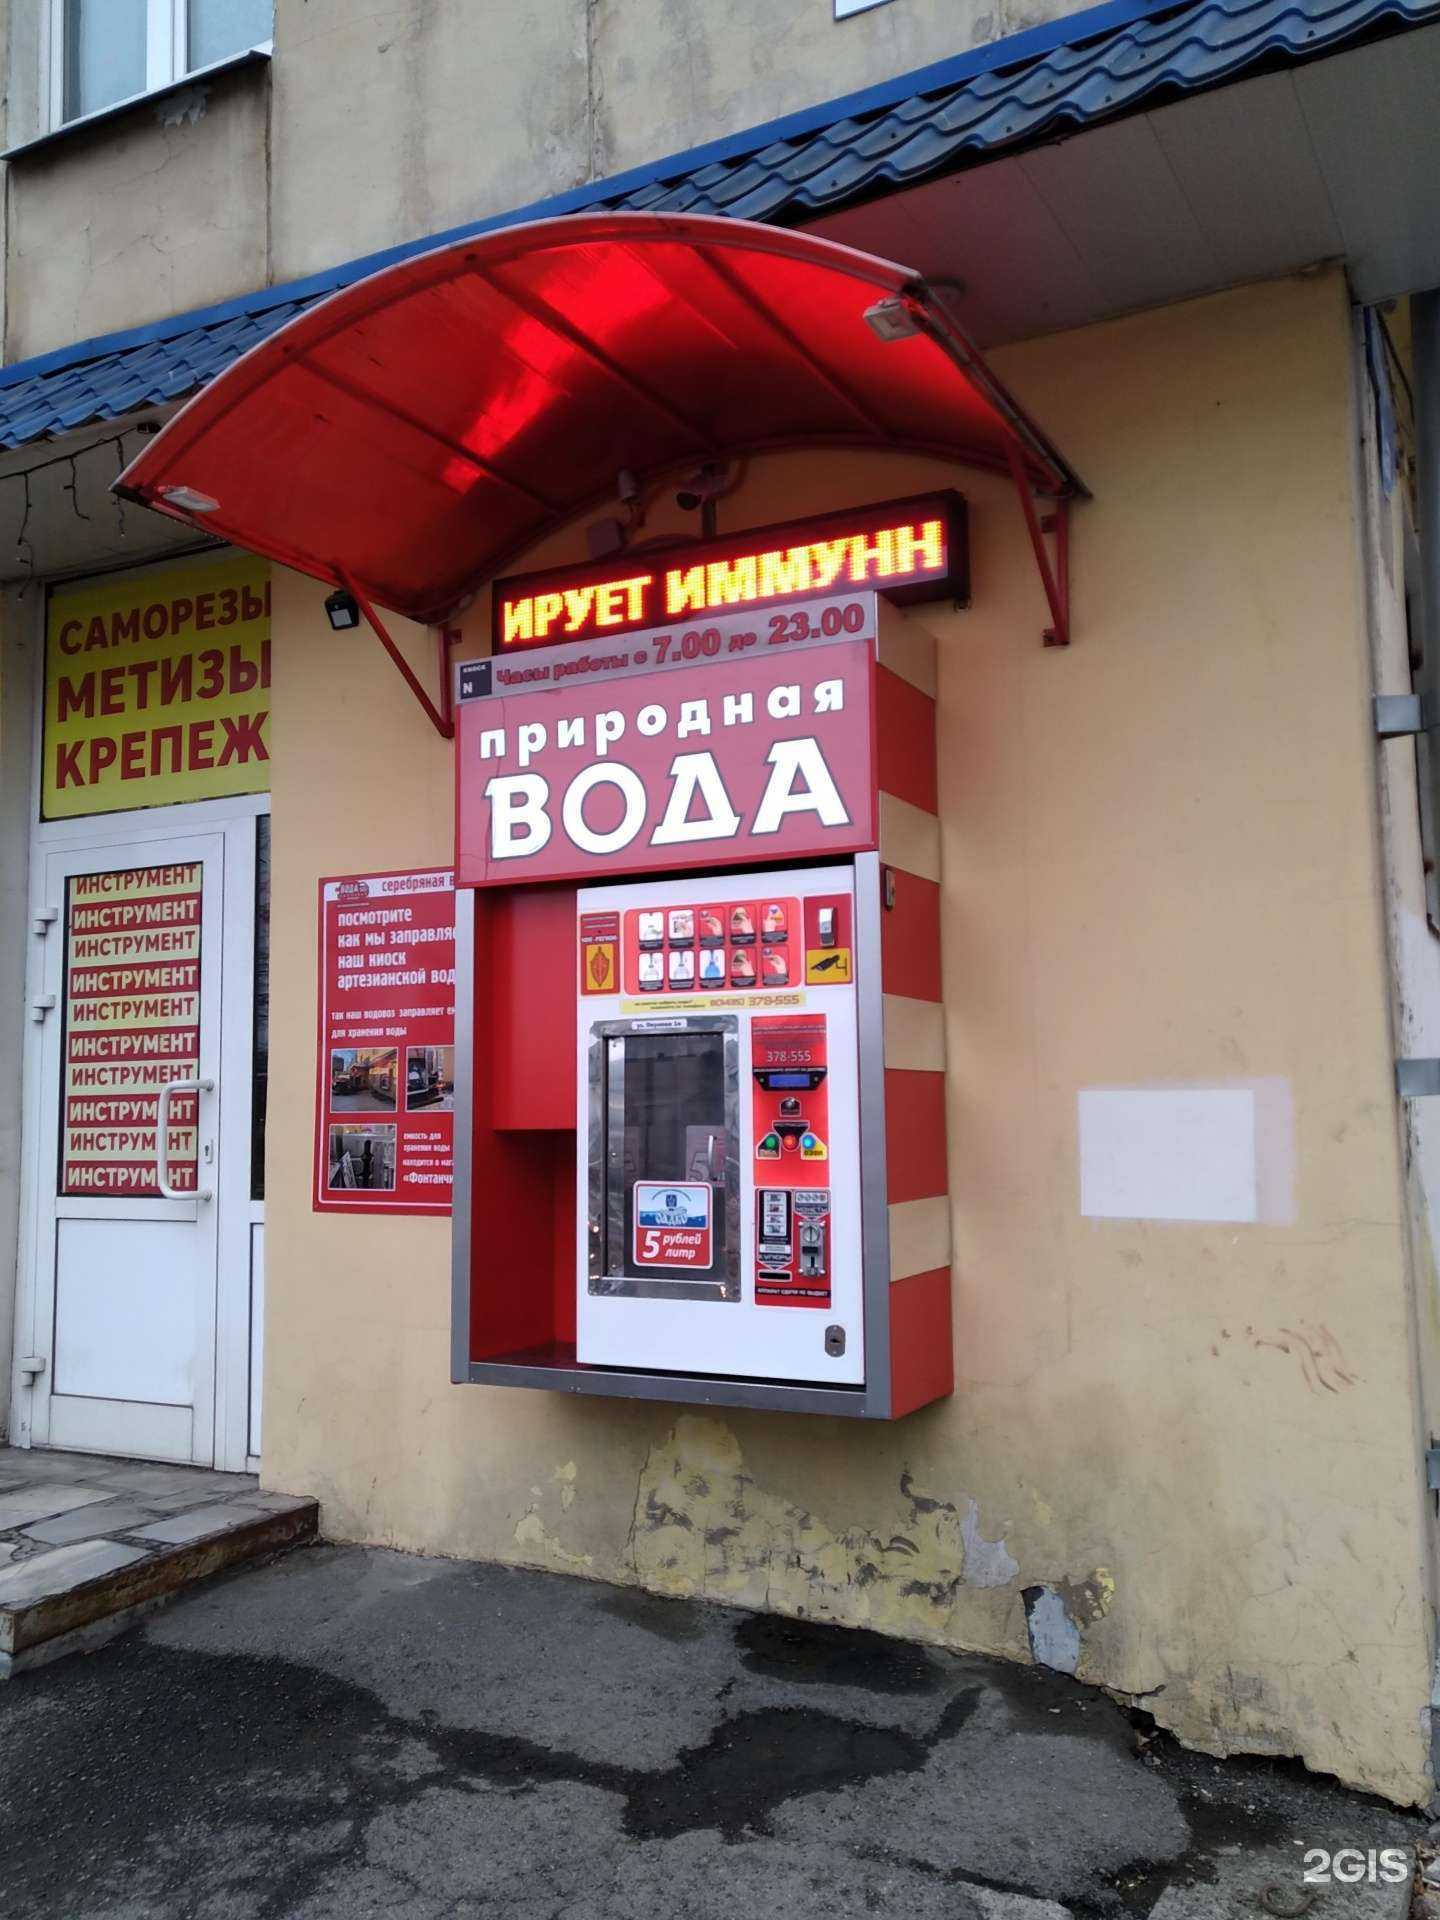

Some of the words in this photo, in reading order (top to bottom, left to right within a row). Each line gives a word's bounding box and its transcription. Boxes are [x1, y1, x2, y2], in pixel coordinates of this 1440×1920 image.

[503, 575, 651, 643] ИРУЕТ
[665, 521, 943, 614] ИММУНН
[59, 581, 271, 655] САМОРЕЗЫ
[496, 667, 549, 686] Часы
[554, 654, 628, 680] работы
[652, 628, 721, 664] 7.00
[729, 632, 757, 651] до
[768, 603, 865, 645] 23.00
[57, 640, 271, 722] МЕТИЗЫ
[479, 678, 846, 767] природная
[56, 711, 271, 789] КРЕПЕЖ
[484, 735, 852, 860] ВОДА
[76, 864, 197, 895] ИНСТРУМЕНТ
[382, 876, 445, 893] серебряная
[74, 900, 197, 929] ИНСТРУМЕНТ
[338, 908, 412, 927] посмотрите
[75, 931, 195, 958] ИНСТРУМЕНТ
[338, 933, 360, 948] как
[365, 931, 385, 945] мы
[338, 954, 364, 969] наш
[369, 952, 406, 967] киоск
[72, 965, 196, 993] ИНСТРУМЕНТ
[337, 968, 425, 991] артезианской
[73, 997, 194, 1022] ИНСТРУМЕНТ
[71, 1032, 195, 1056] ИНСТРУМЕНТ
[767, 1050, 812, 1062] 378-555
[72, 1064, 193, 1086] ИНСТРУМЕНТ
[70, 1100, 194, 1121] ИНСТРУМНТ
[70, 1132, 192, 1151] ИНСТРУМНТ
[68, 1167, 193, 1187] ИНСТРУМНТ
[642, 1231, 660, 1258] 5
[663, 1233, 702, 1245] рублей
[665, 1248, 696, 1260] литр
